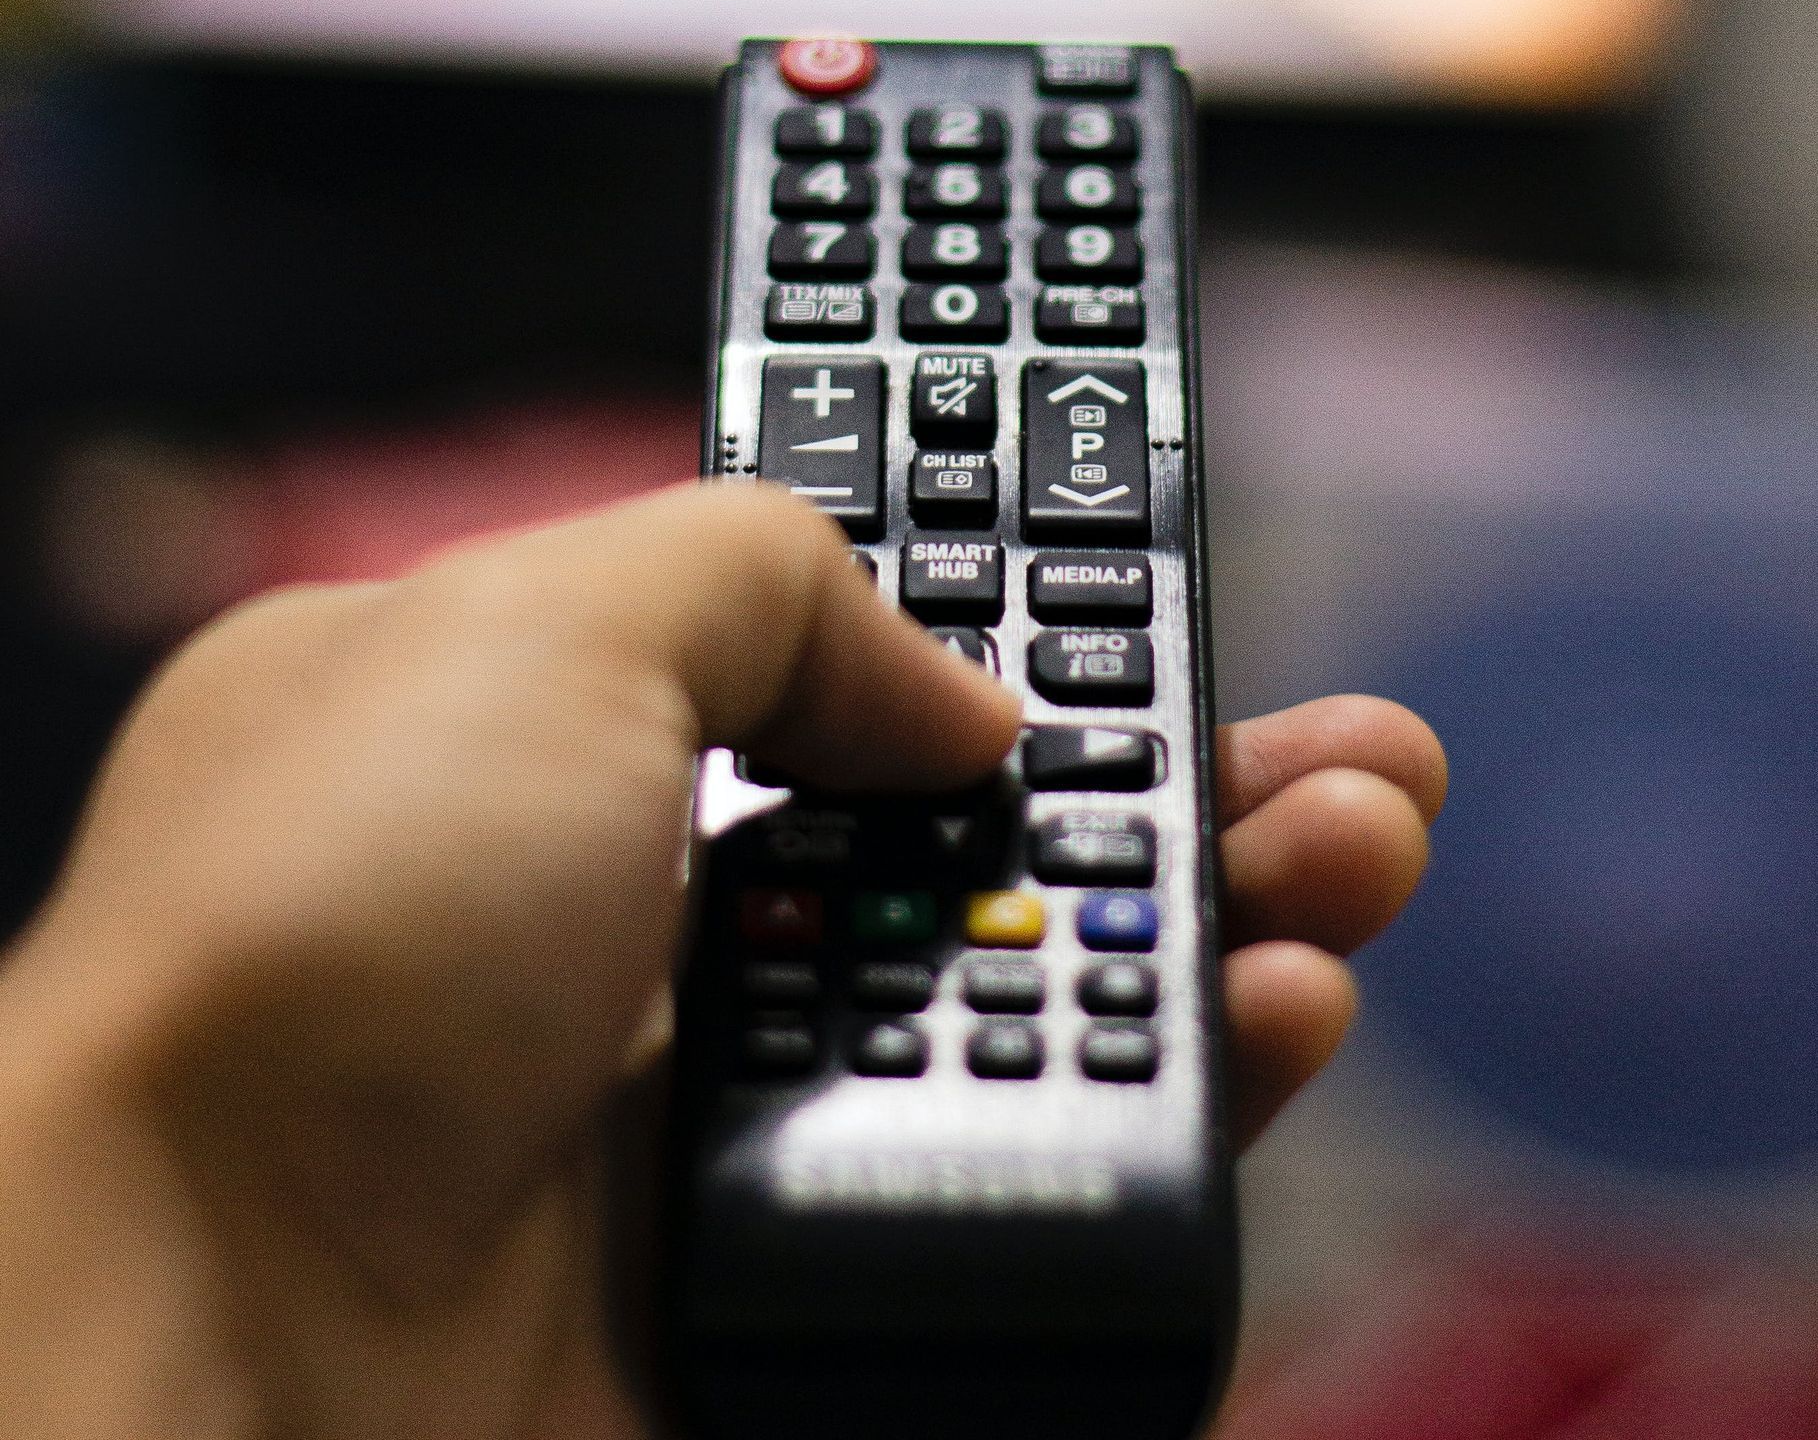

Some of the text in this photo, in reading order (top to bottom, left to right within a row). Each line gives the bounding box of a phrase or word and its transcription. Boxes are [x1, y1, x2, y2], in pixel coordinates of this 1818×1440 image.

[816, 106, 844, 146] 1
[935, 107, 983, 147] 2
[1066, 106, 1113, 147] 3
[808, 164, 848, 204] 4
[934, 165, 981, 204] 5
[1066, 165, 1113, 205] 6
[804, 224, 845, 260] 7
[934, 224, 981, 264] 8
[1067, 225, 1113, 264] 9
[780, 286, 863, 301] TTX/MIX
[934, 285, 977, 323] 0
[1047, 287, 1134, 303] PRE-CH
[923, 357, 986, 375] MUTE
[922, 454, 987, 468] CH LIST
[1072, 432, 1104, 460] P
[911, 543, 997, 562] SMART
[928, 560, 979, 580] HUB
[1042, 566, 1142, 585] MEDIA.P
[1061, 633, 1129, 653] INFO
